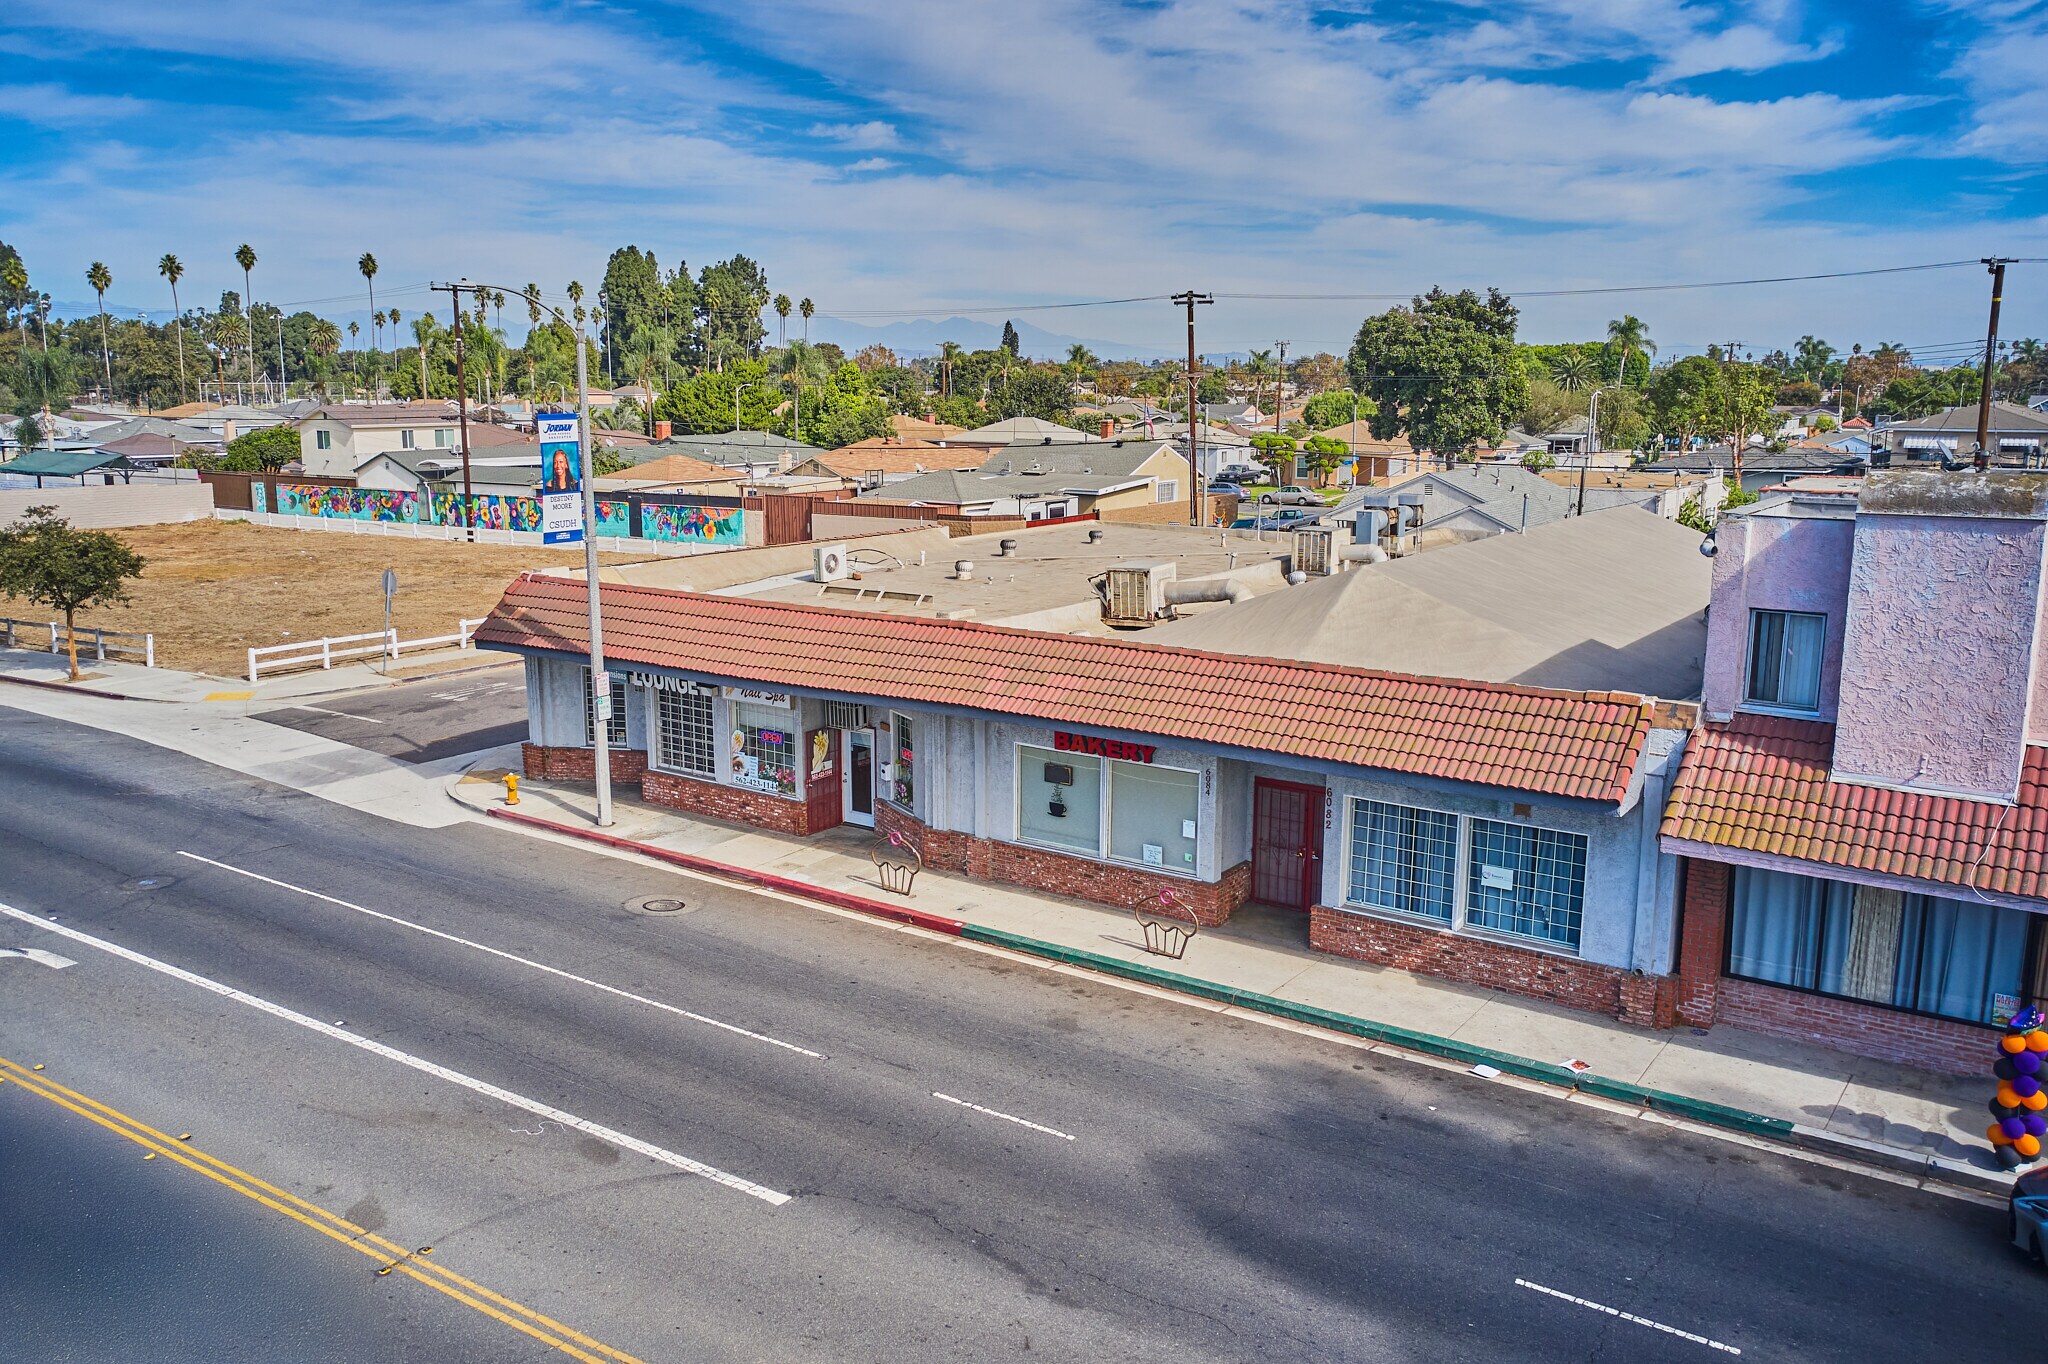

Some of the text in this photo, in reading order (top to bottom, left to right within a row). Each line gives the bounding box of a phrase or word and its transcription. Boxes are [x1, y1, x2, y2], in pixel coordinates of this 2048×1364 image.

[543, 424, 573, 433] JORDAN
[549, 519, 577, 529] CSUDH
[633, 671, 698, 695] LOUNGE
[740, 688, 786, 705] Nail Spa
[761, 731, 782, 743] OPEN
[1054, 731, 1156, 763] BAKERY
[734, 776, 779, 790] 562-423-1144
